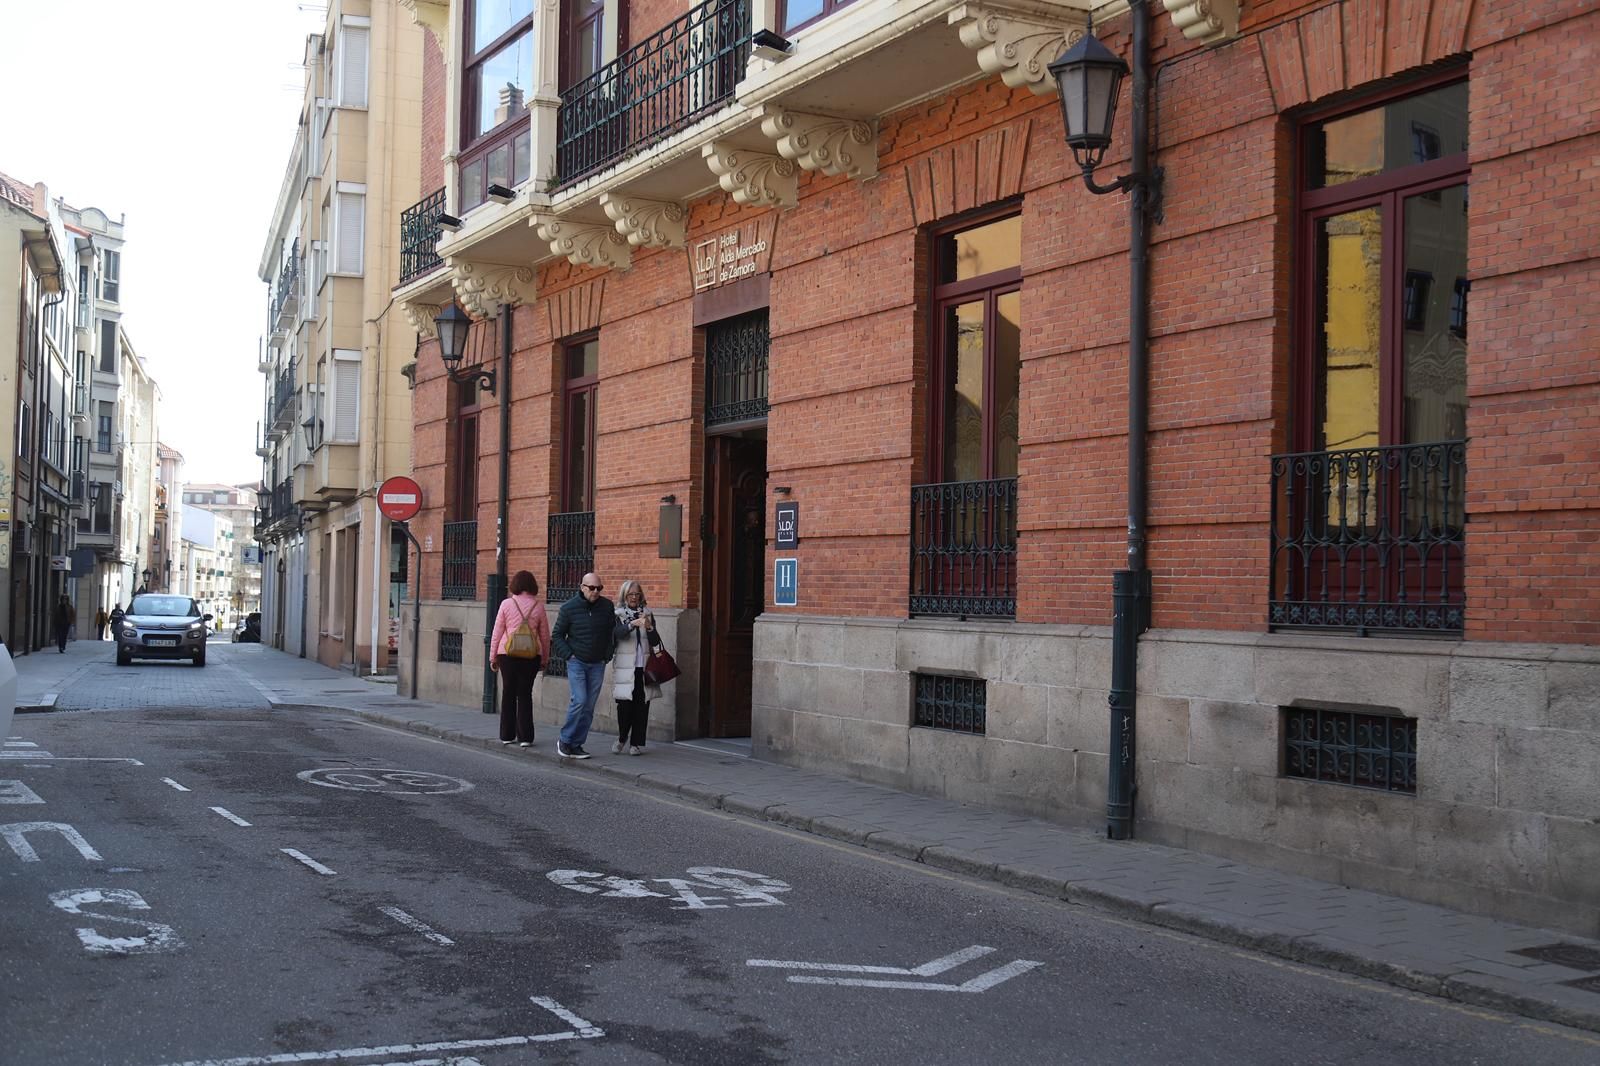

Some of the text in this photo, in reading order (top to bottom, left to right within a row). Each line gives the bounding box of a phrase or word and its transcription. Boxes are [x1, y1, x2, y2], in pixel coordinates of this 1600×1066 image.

[720, 230, 737, 247] Hotel
[720, 239, 766, 264] Alda Mercado
[720, 268, 728, 282] de
[728, 262, 755, 279] Zamora
[780, 565, 791, 587] H
